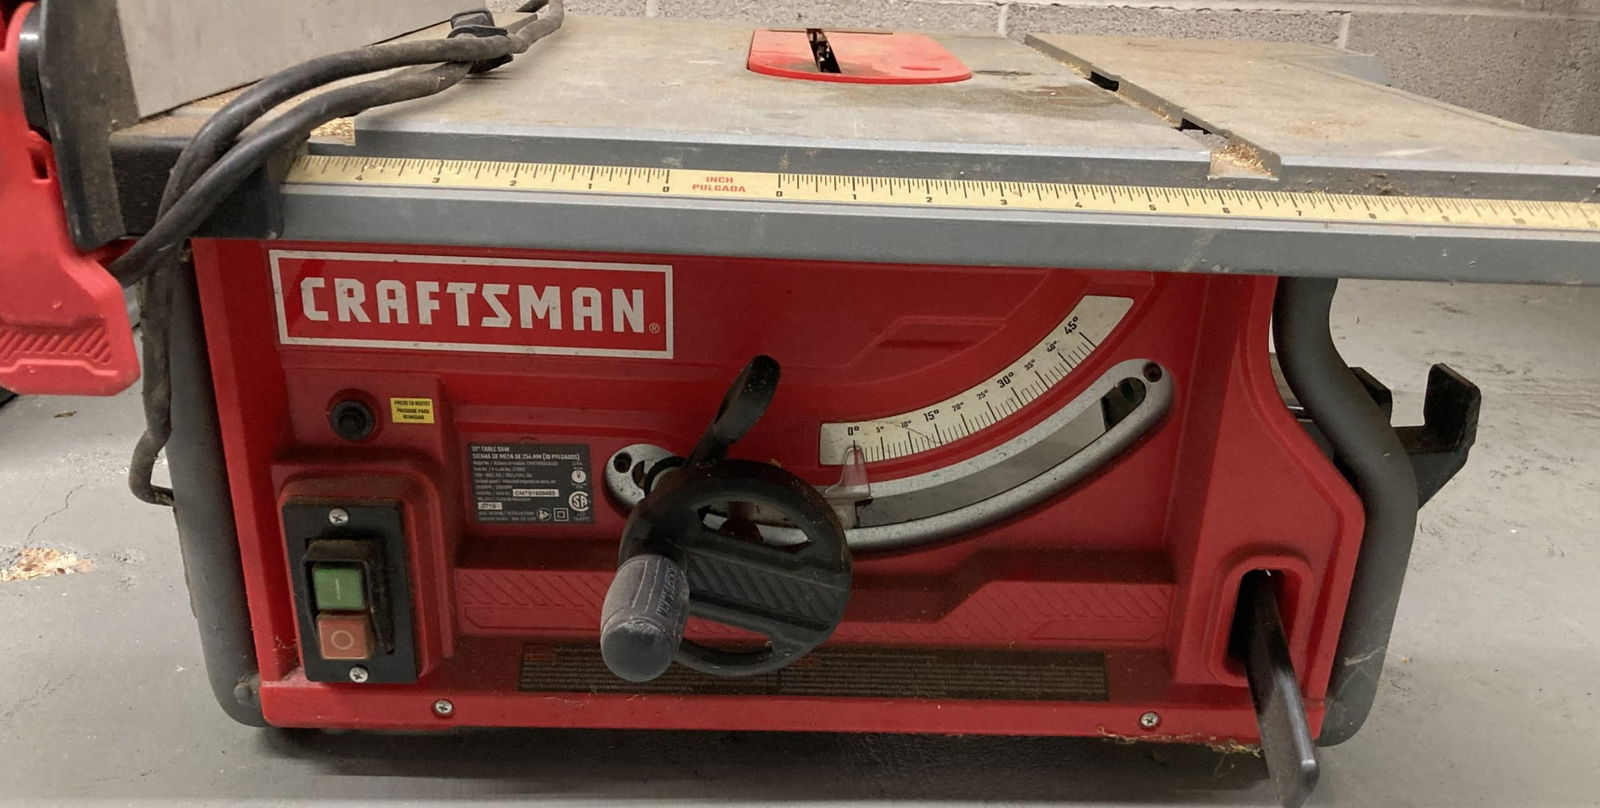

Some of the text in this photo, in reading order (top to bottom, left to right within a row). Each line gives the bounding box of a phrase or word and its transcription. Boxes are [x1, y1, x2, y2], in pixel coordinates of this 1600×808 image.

[705, 175, 734, 184] INCH
[692, 183, 746, 193] PULGADA
[775, 190, 783, 198] 0
[301, 276, 645, 333] CRAFTSMAN
[923, 409, 939, 422] 15°
[996, 371, 1014, 389] 30°
[1064, 315, 1079, 335] 45°
